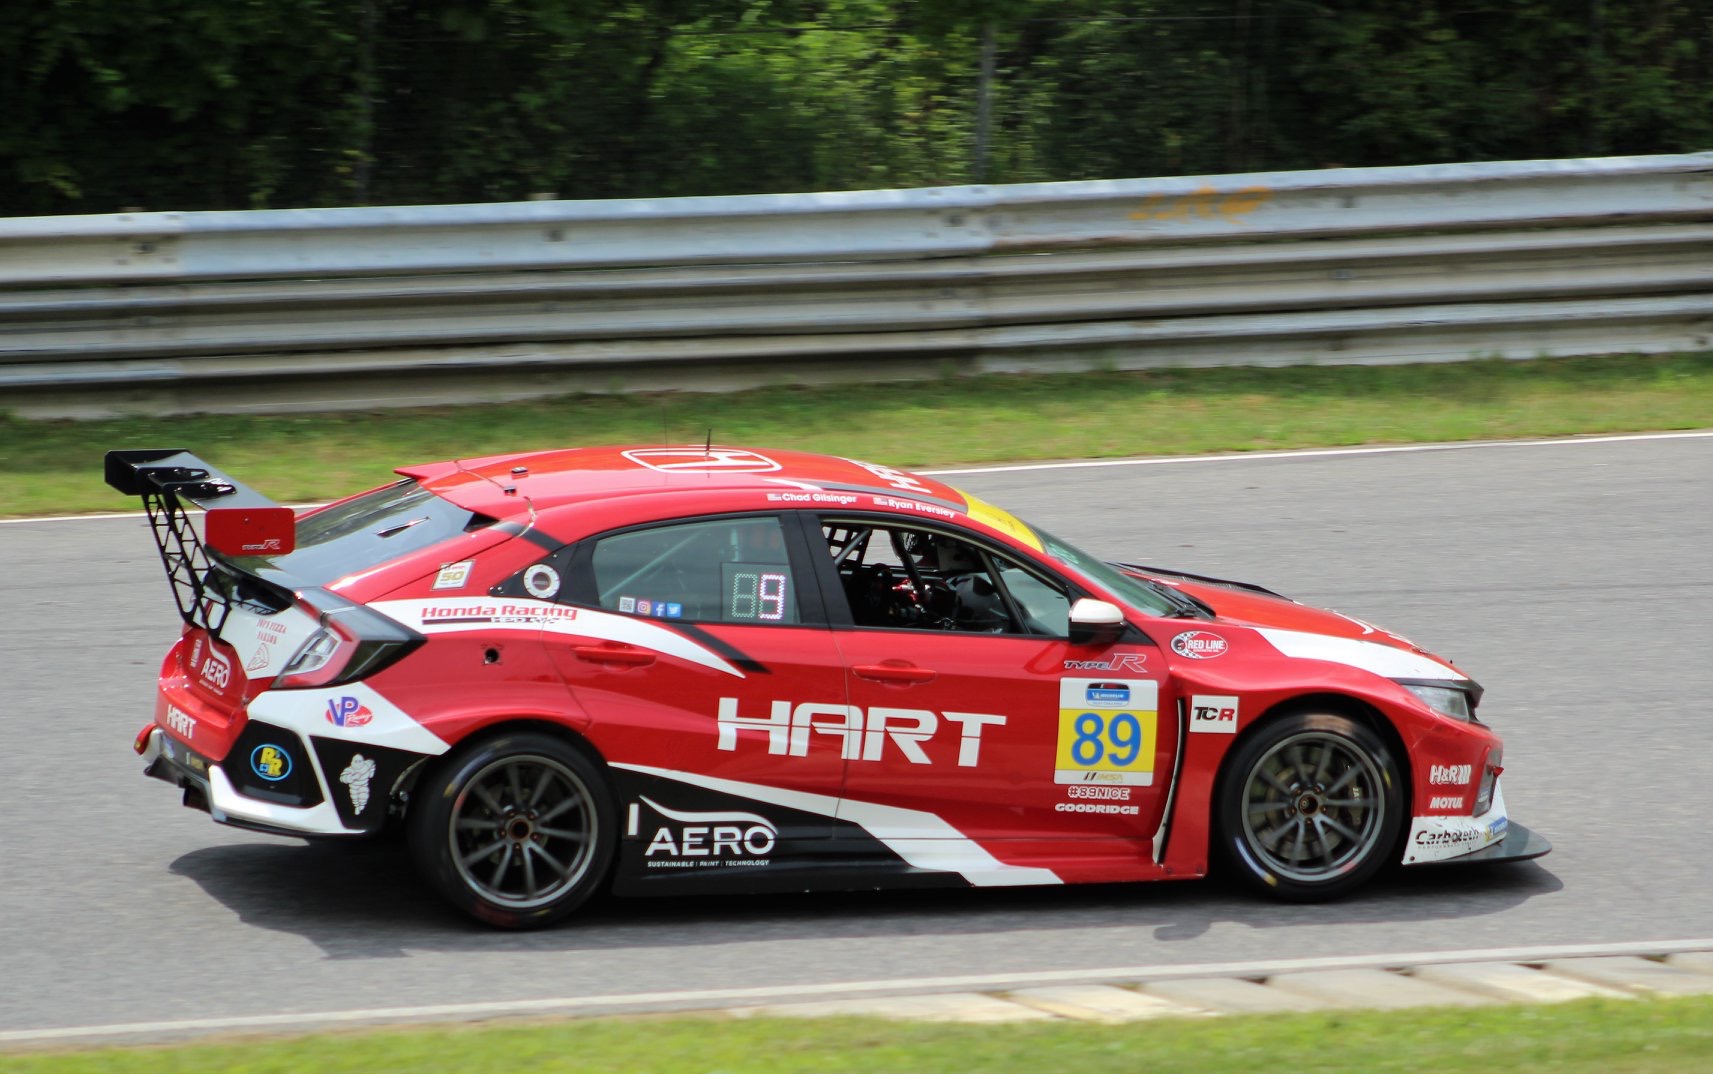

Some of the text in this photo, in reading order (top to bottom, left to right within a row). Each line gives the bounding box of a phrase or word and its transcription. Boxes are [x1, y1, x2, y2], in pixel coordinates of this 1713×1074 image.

[782, 492, 857, 504] Chad Gilsinger
[888, 499, 955, 518] Ryan Eversley
[421, 605, 493, 618] Honda
[500, 605, 577, 621] Racing
[1188, 640, 1225, 650] RED LINE
[1064, 653, 1148, 673] TYPE R
[200, 657, 230, 690] AERO
[328, 696, 359, 727] VP
[1194, 706, 1235, 721] TCR
[166, 704, 197, 739] HART
[717, 697, 1007, 767] HART
[1071, 713, 1142, 767] 89
[1067, 786, 1131, 800] #89NICE
[1055, 803, 1139, 815] GOODRIDGE
[1430, 797, 1463, 809] MOTUL
[645, 827, 776, 857] AERO
